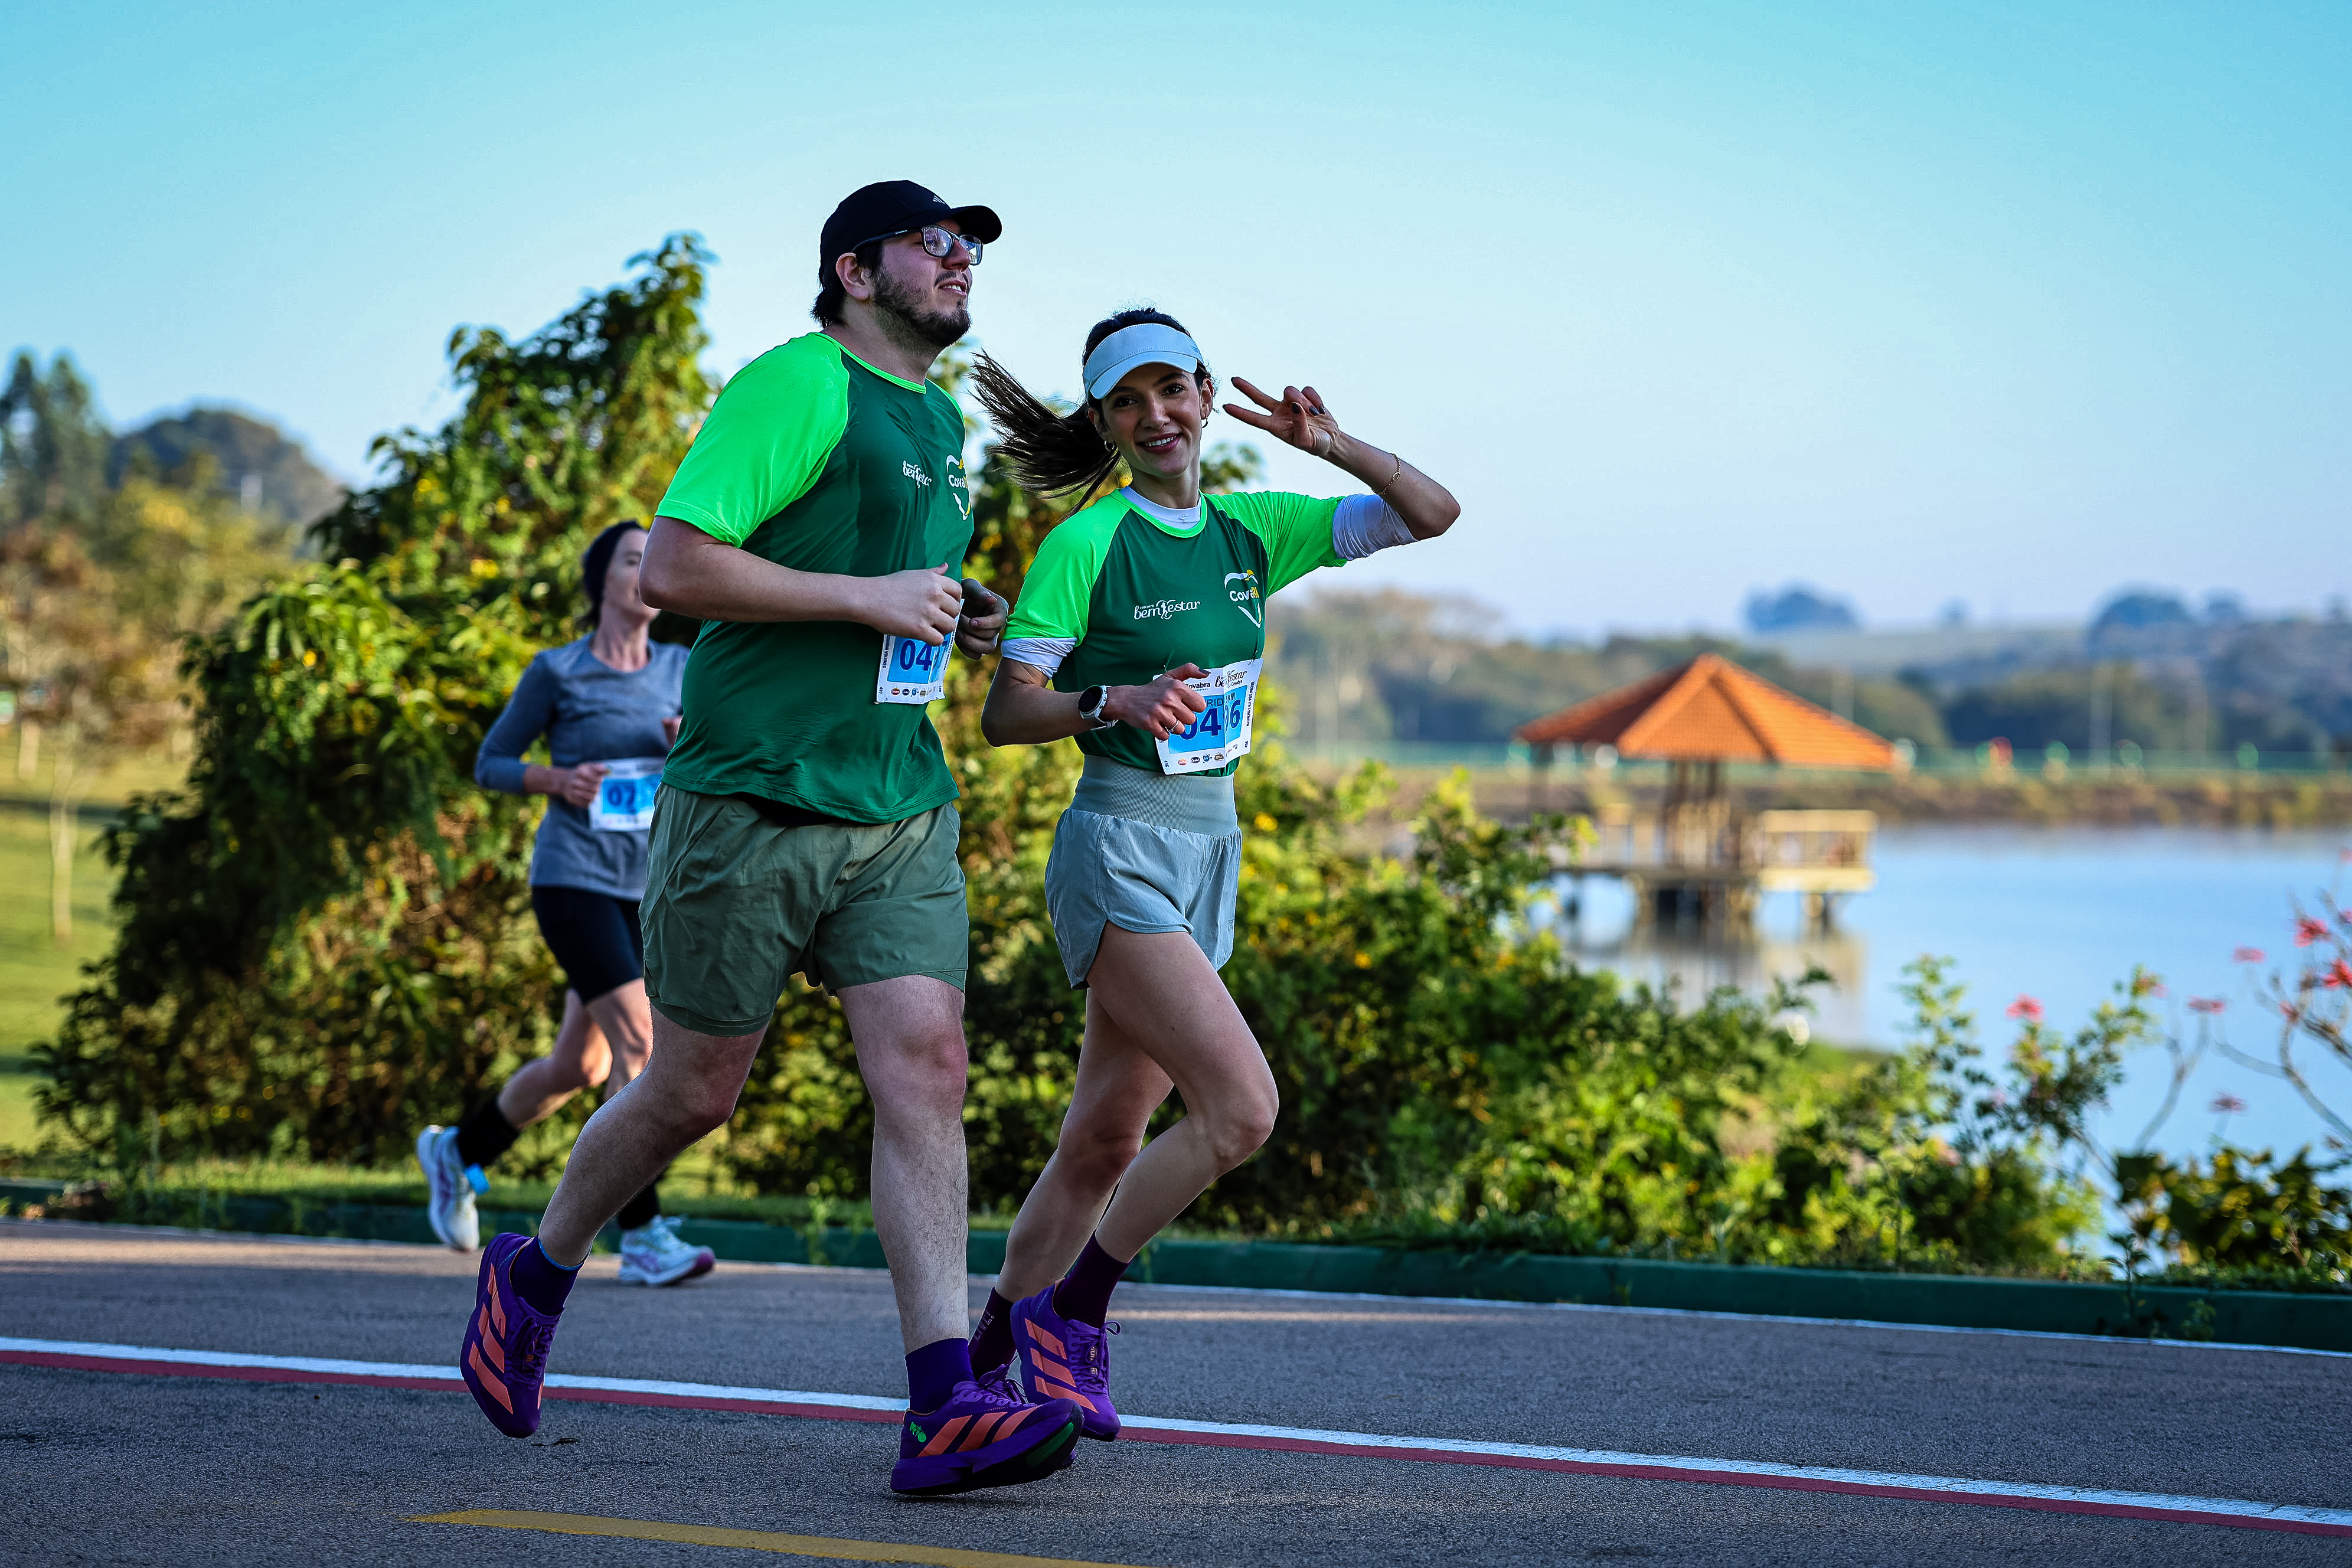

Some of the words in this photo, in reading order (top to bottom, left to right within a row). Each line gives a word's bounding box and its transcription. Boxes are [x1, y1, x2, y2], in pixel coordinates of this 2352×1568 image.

[948, 474, 968, 489] Cova
[1133, 605, 1161, 620] bem
[1168, 600, 1201, 613] estar
